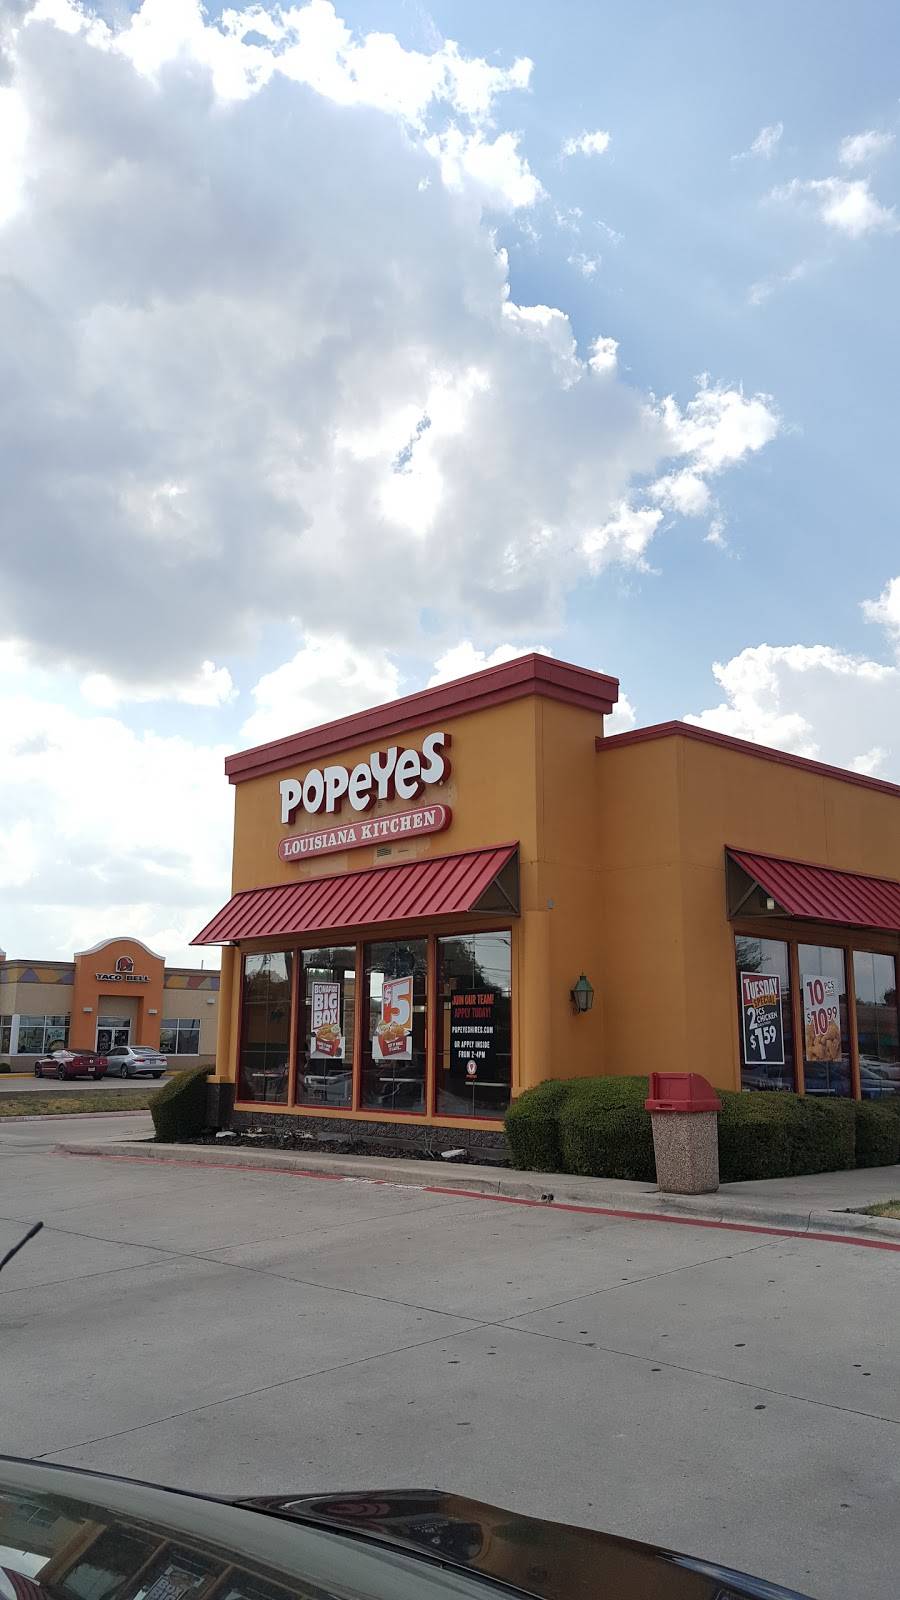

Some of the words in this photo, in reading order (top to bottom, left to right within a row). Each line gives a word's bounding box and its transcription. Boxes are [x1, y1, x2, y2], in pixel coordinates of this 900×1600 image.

[284, 828, 356, 857] LOUISIANA
[361, 809, 437, 840] KITCHEN
[96, 972, 122, 981] TACO
[125, 974, 151, 983] BELL
[744, 977, 777, 1000] TUESDAY
[806, 979, 825, 1006] 10
[314, 992, 338, 1011] BIG
[465, 994, 477, 1005] OUR
[313, 1007, 338, 1029] BOX
[747, 1007, 758, 1031] 2
[756, 1011, 778, 1024] CHICKEN
[454, 1040, 461, 1049] OR
[461, 1040, 474, 1049] APPLY
[475, 1040, 490, 1049] INSIDE
[458, 1050, 470, 1059] FROM
[471, 1050, 486, 1059] 2-4PM
